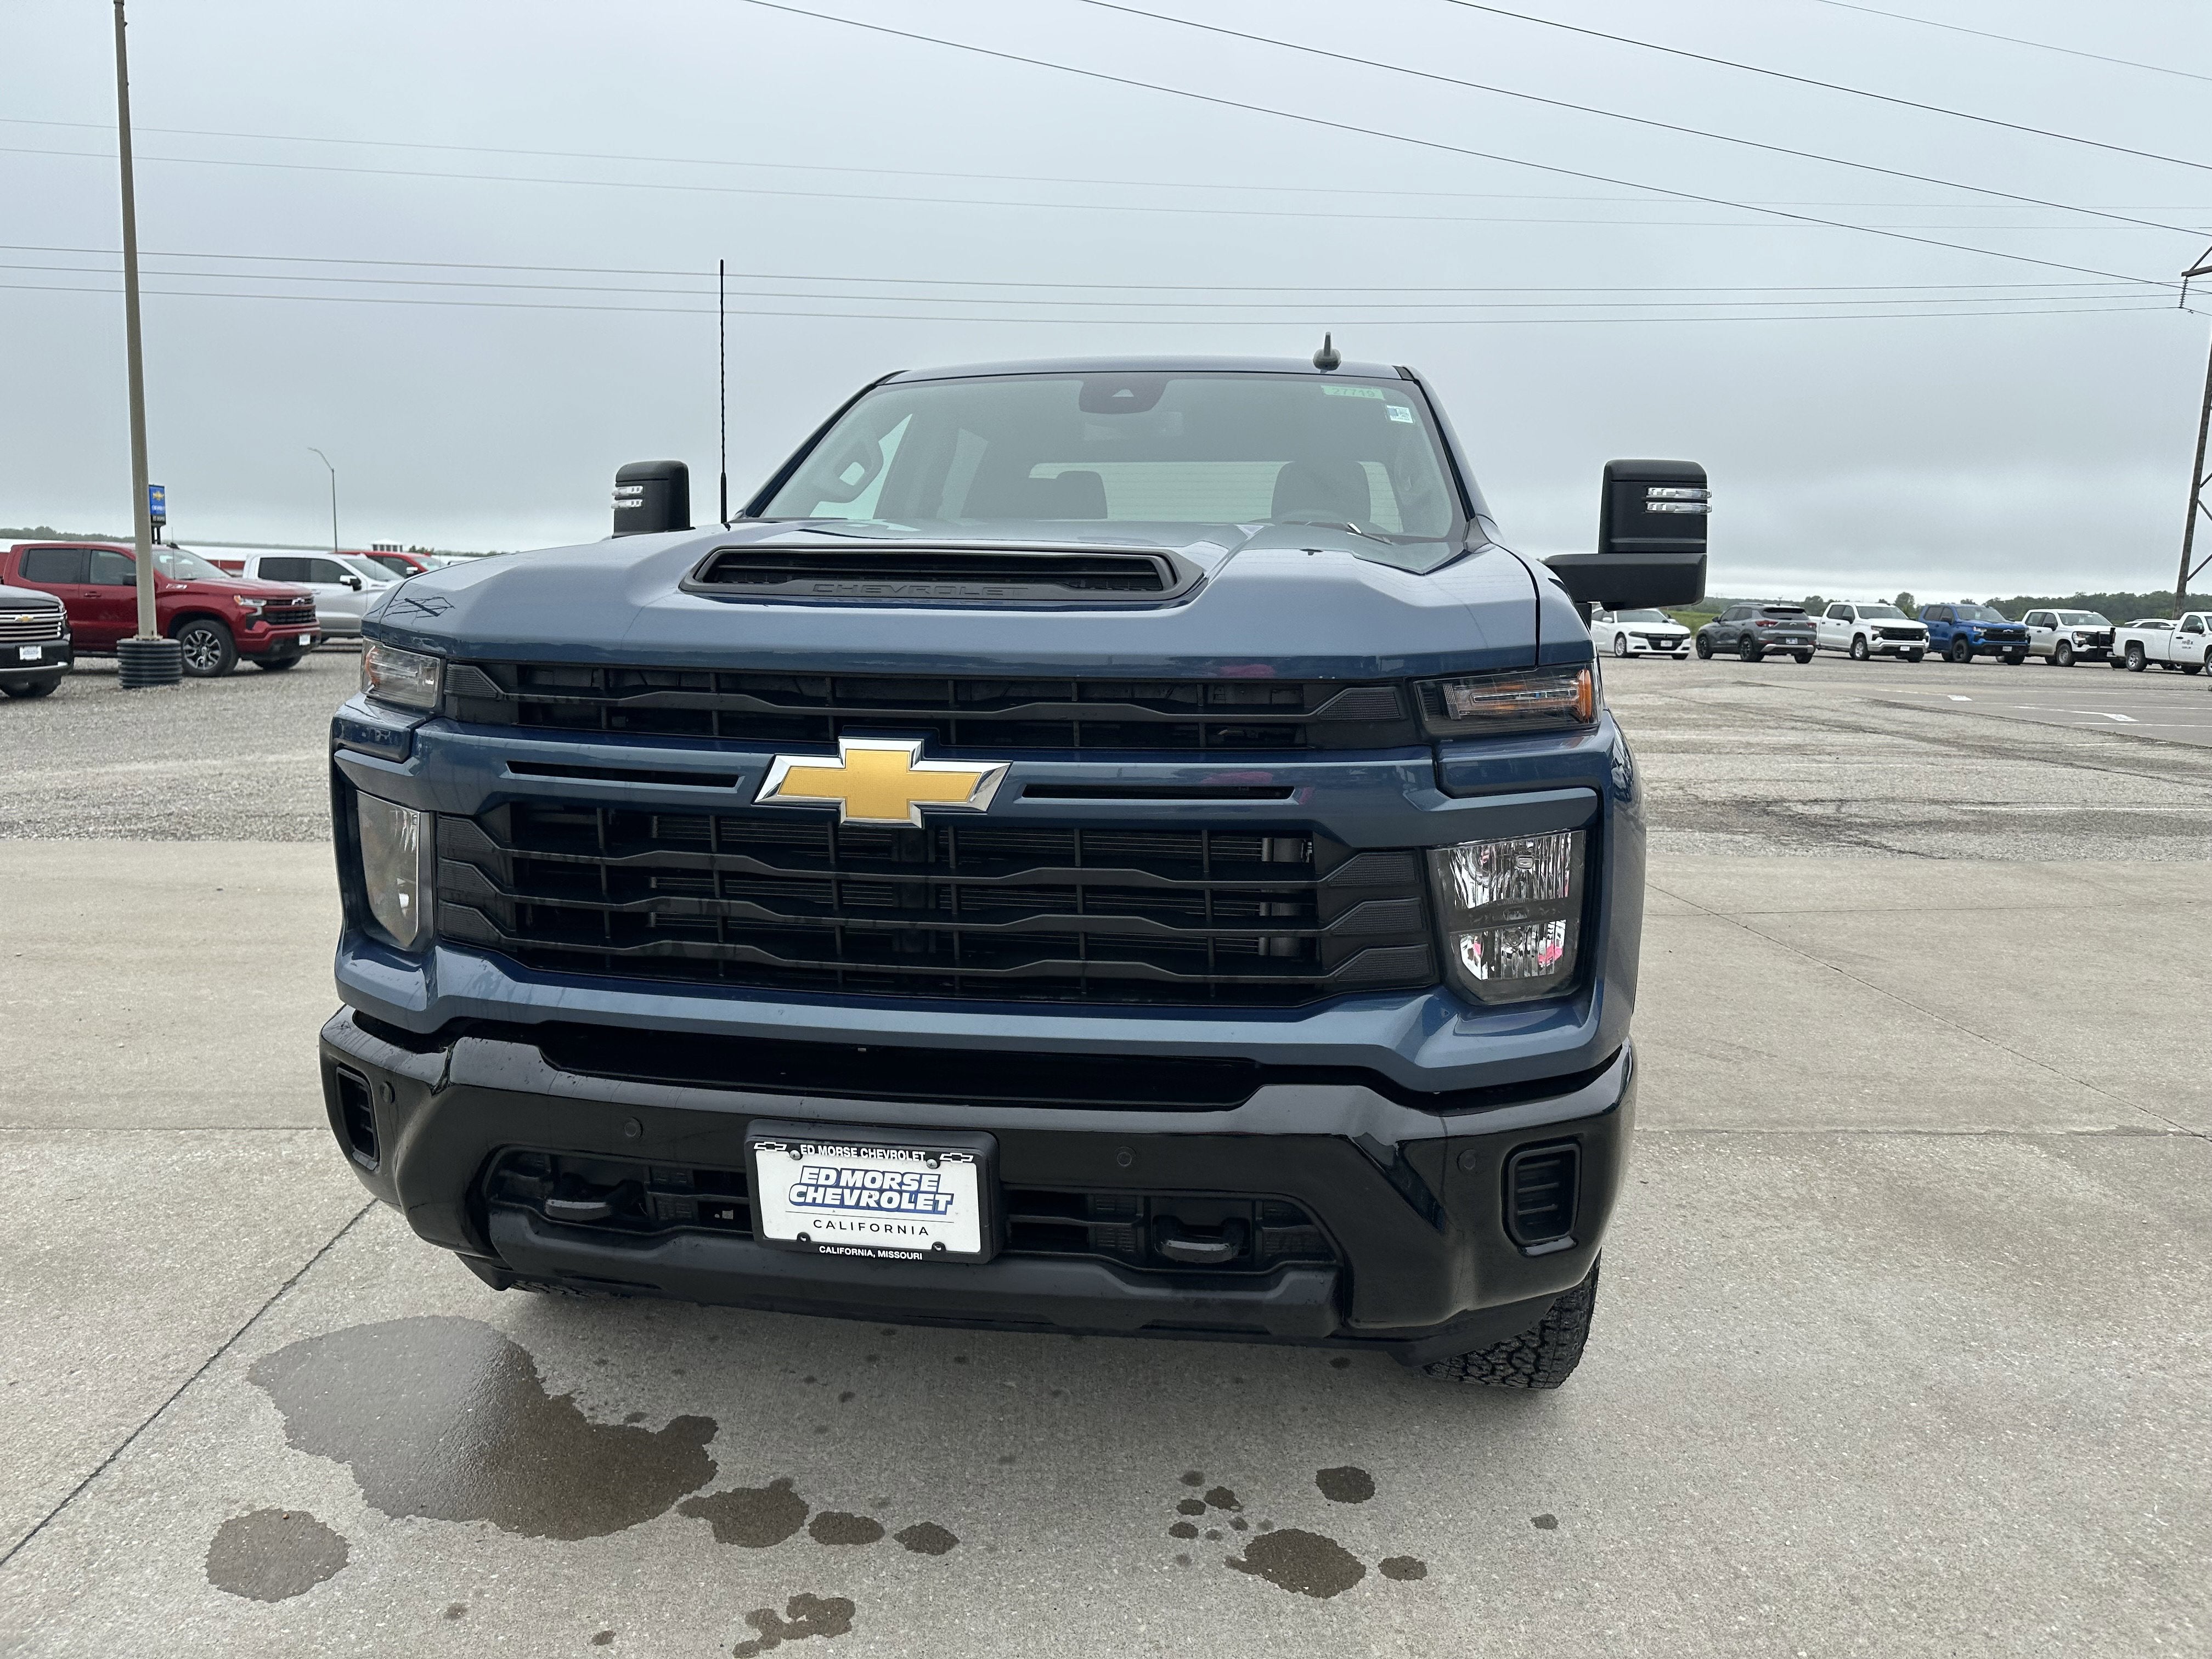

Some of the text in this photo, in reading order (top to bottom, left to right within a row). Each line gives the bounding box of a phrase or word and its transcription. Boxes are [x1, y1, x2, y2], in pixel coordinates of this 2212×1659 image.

[812, 584, 1029, 597] CHEVROLET
[800, 1144, 926, 1162] ED MORSE CHEVROLET
[789, 1165, 954, 1215] ED MORSE CHEVROLET
[813, 1220, 929, 1235] CALIFORNIA
[819, 1245, 923, 1260] CALIFORNIA, MISSOURI
